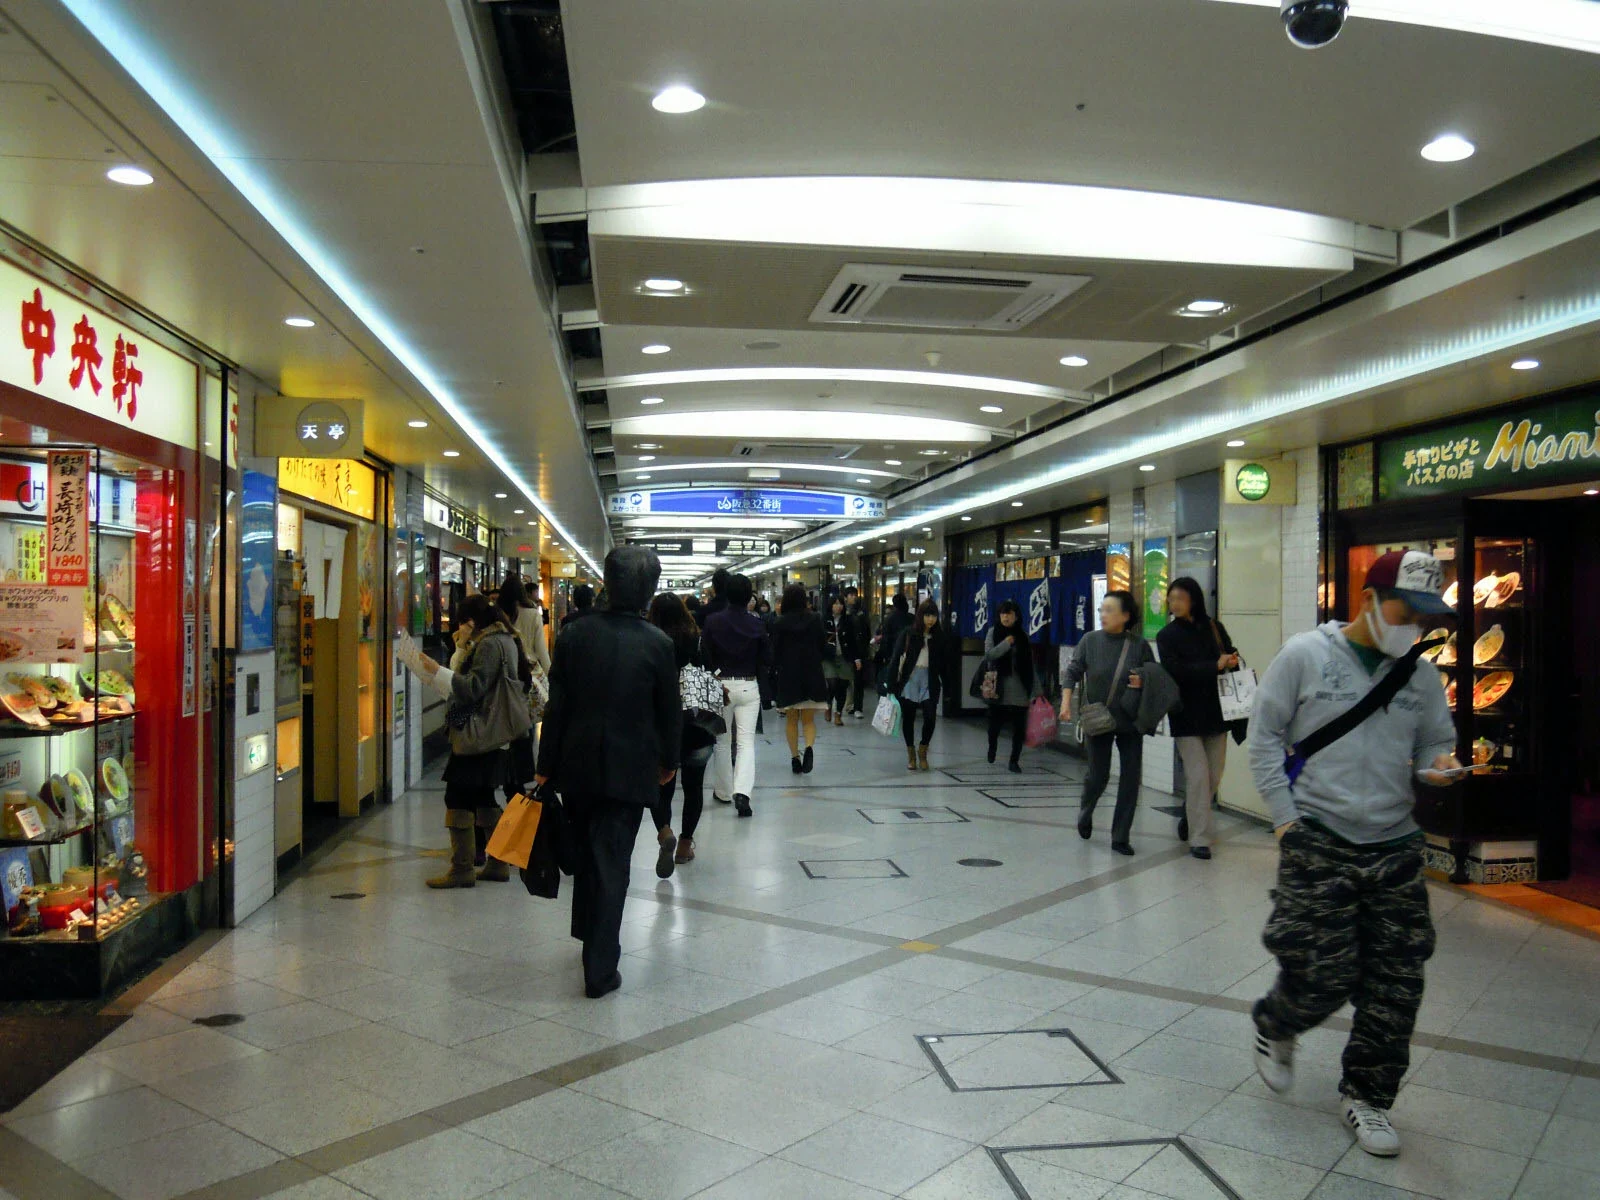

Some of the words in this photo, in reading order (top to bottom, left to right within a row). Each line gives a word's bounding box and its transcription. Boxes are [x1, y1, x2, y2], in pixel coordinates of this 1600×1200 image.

[21, 287, 143, 422] 中央軒
[302, 424, 345, 440] 天亭
[1402, 437, 1481, 470] 手作りピザと
[1407, 459, 1476, 487] パスタの店
